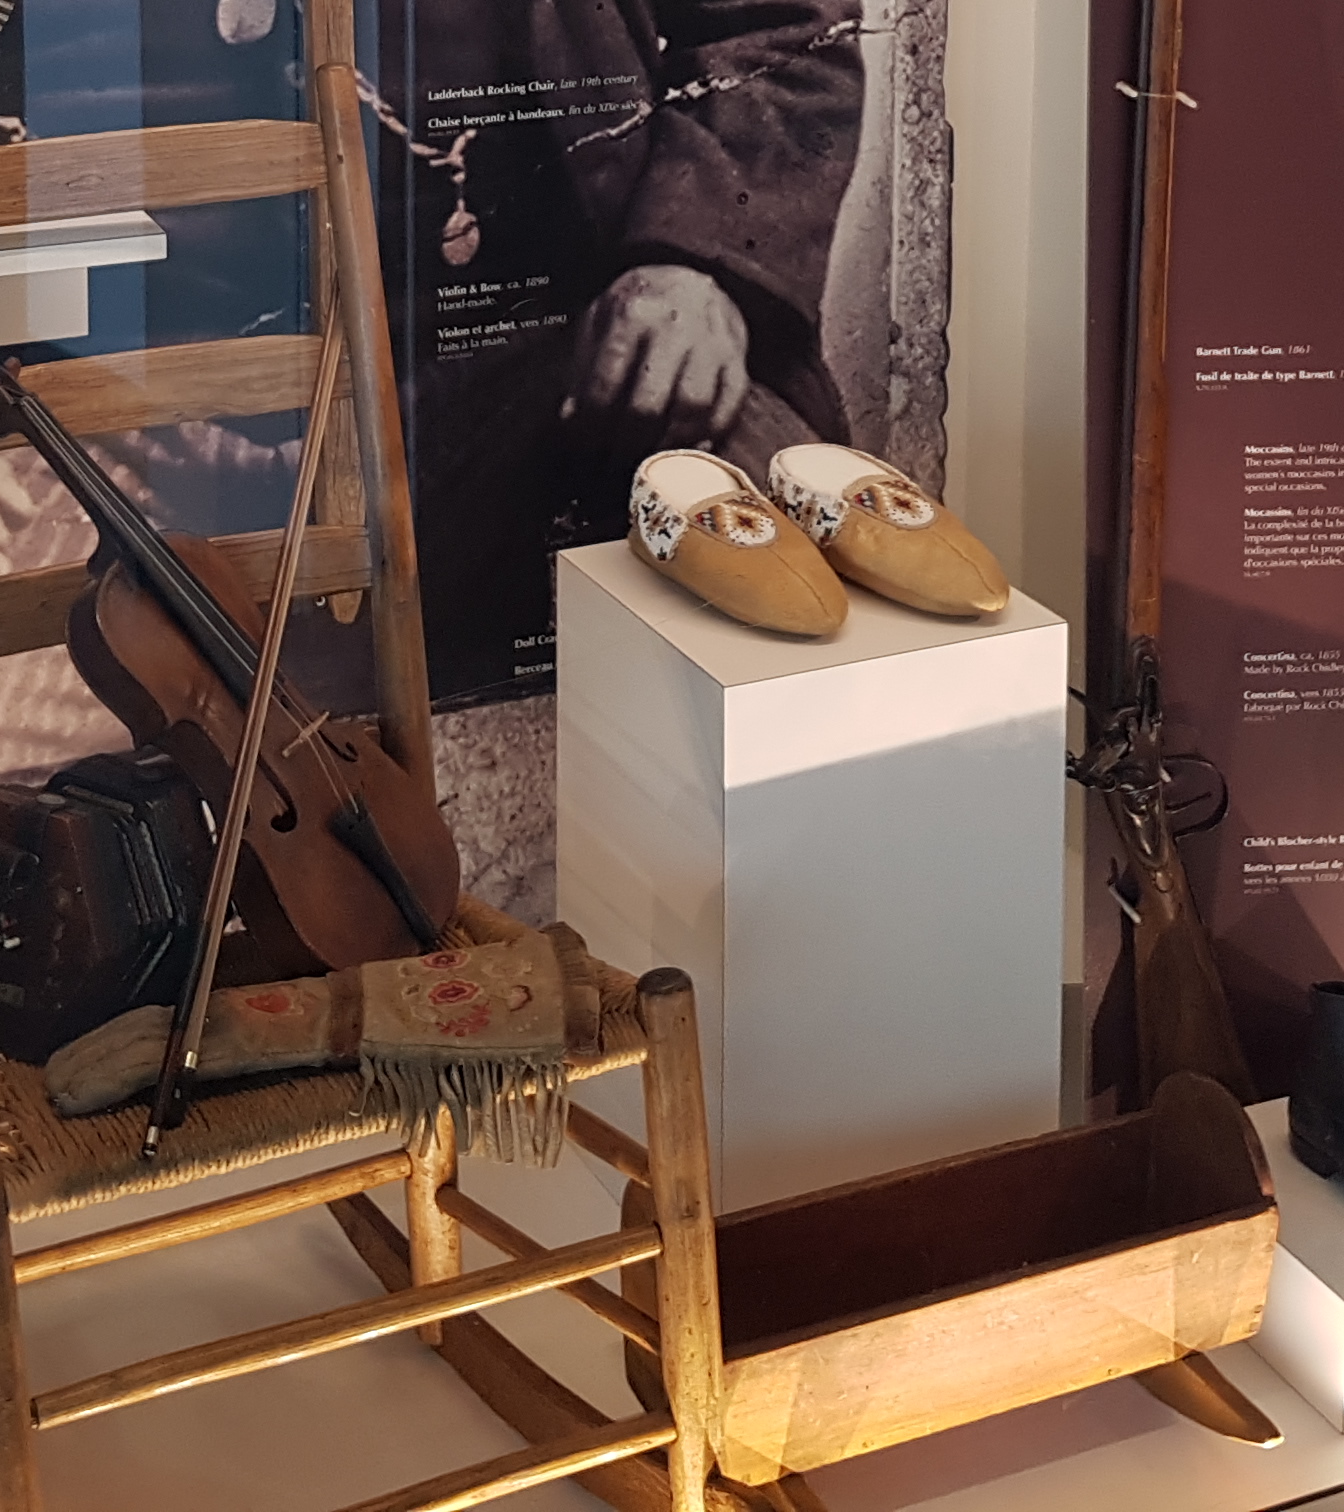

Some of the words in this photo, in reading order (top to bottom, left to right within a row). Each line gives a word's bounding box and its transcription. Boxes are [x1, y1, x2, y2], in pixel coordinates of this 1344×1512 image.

[427, 85, 484, 101] Ladderback
[487, 82, 526, 95] Rocking
[560, 78, 577, 88] late
[581, 75, 600, 87] 19th
